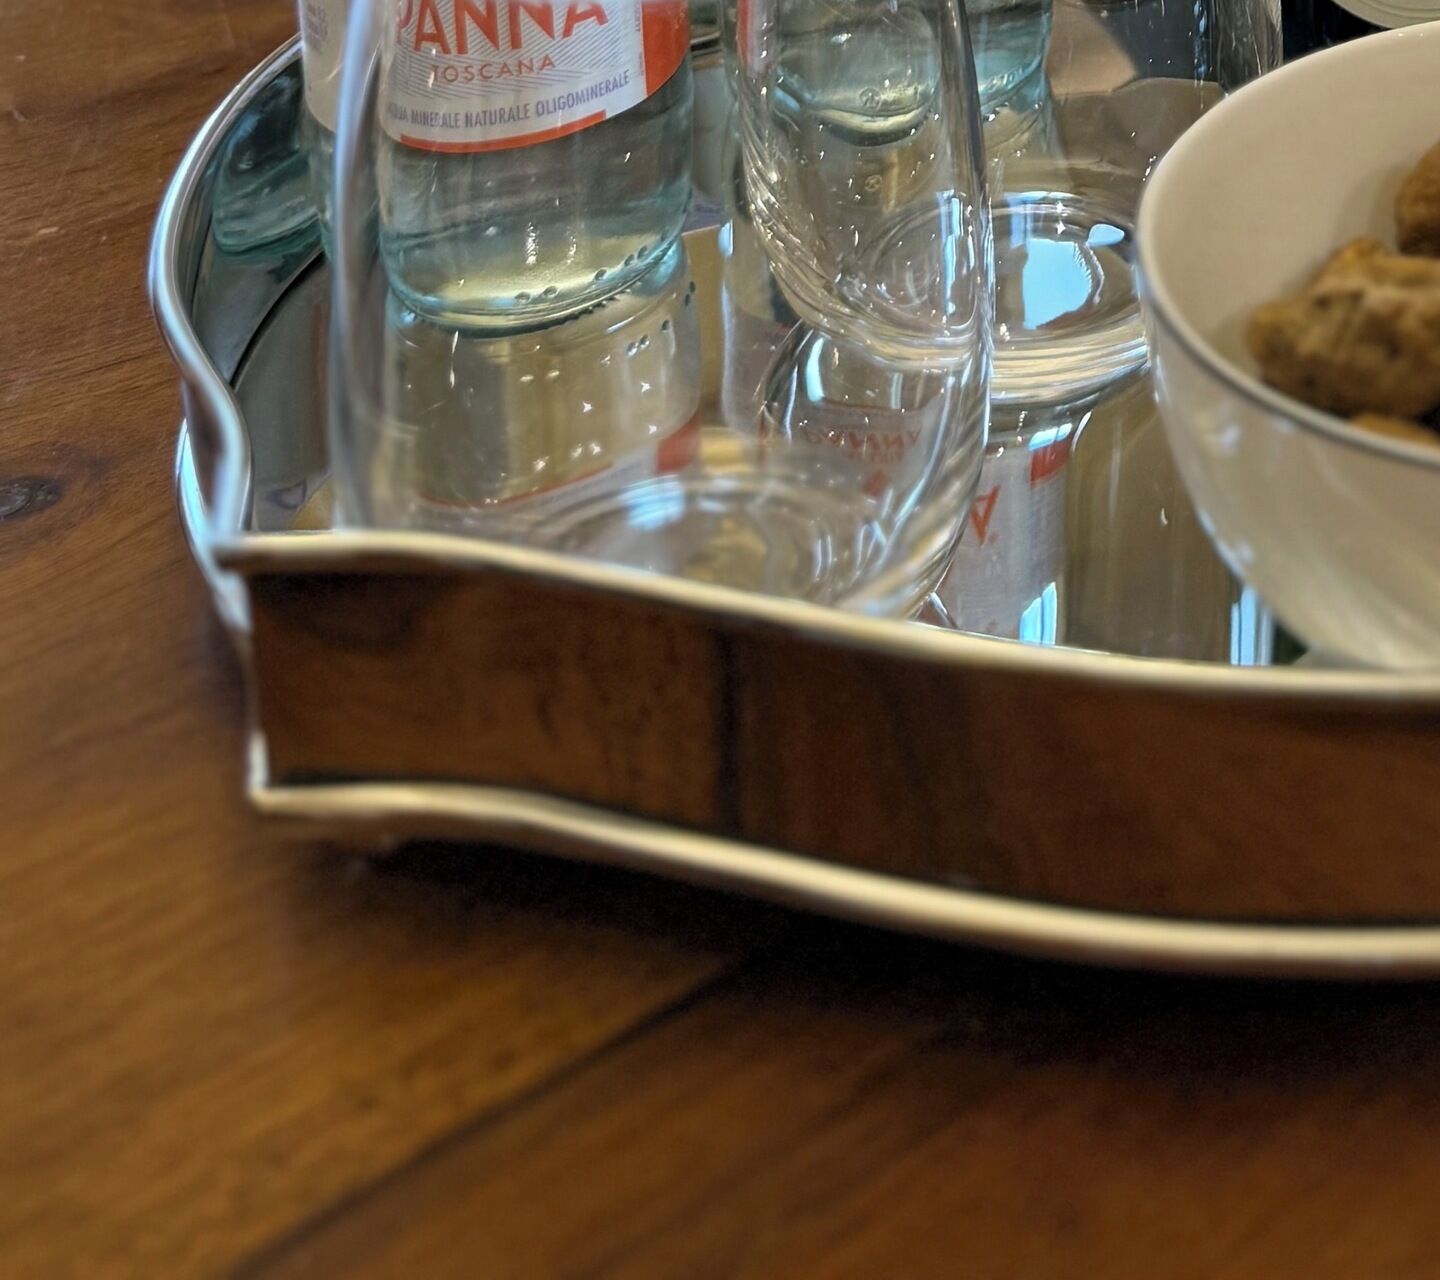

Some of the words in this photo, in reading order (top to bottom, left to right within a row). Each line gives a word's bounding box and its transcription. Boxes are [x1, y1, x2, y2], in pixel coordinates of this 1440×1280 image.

[432, 54, 557, 83] TOSCANA
[465, 104, 531, 128] NATURALE
[535, 69, 631, 118] OLIGOMINERALE
